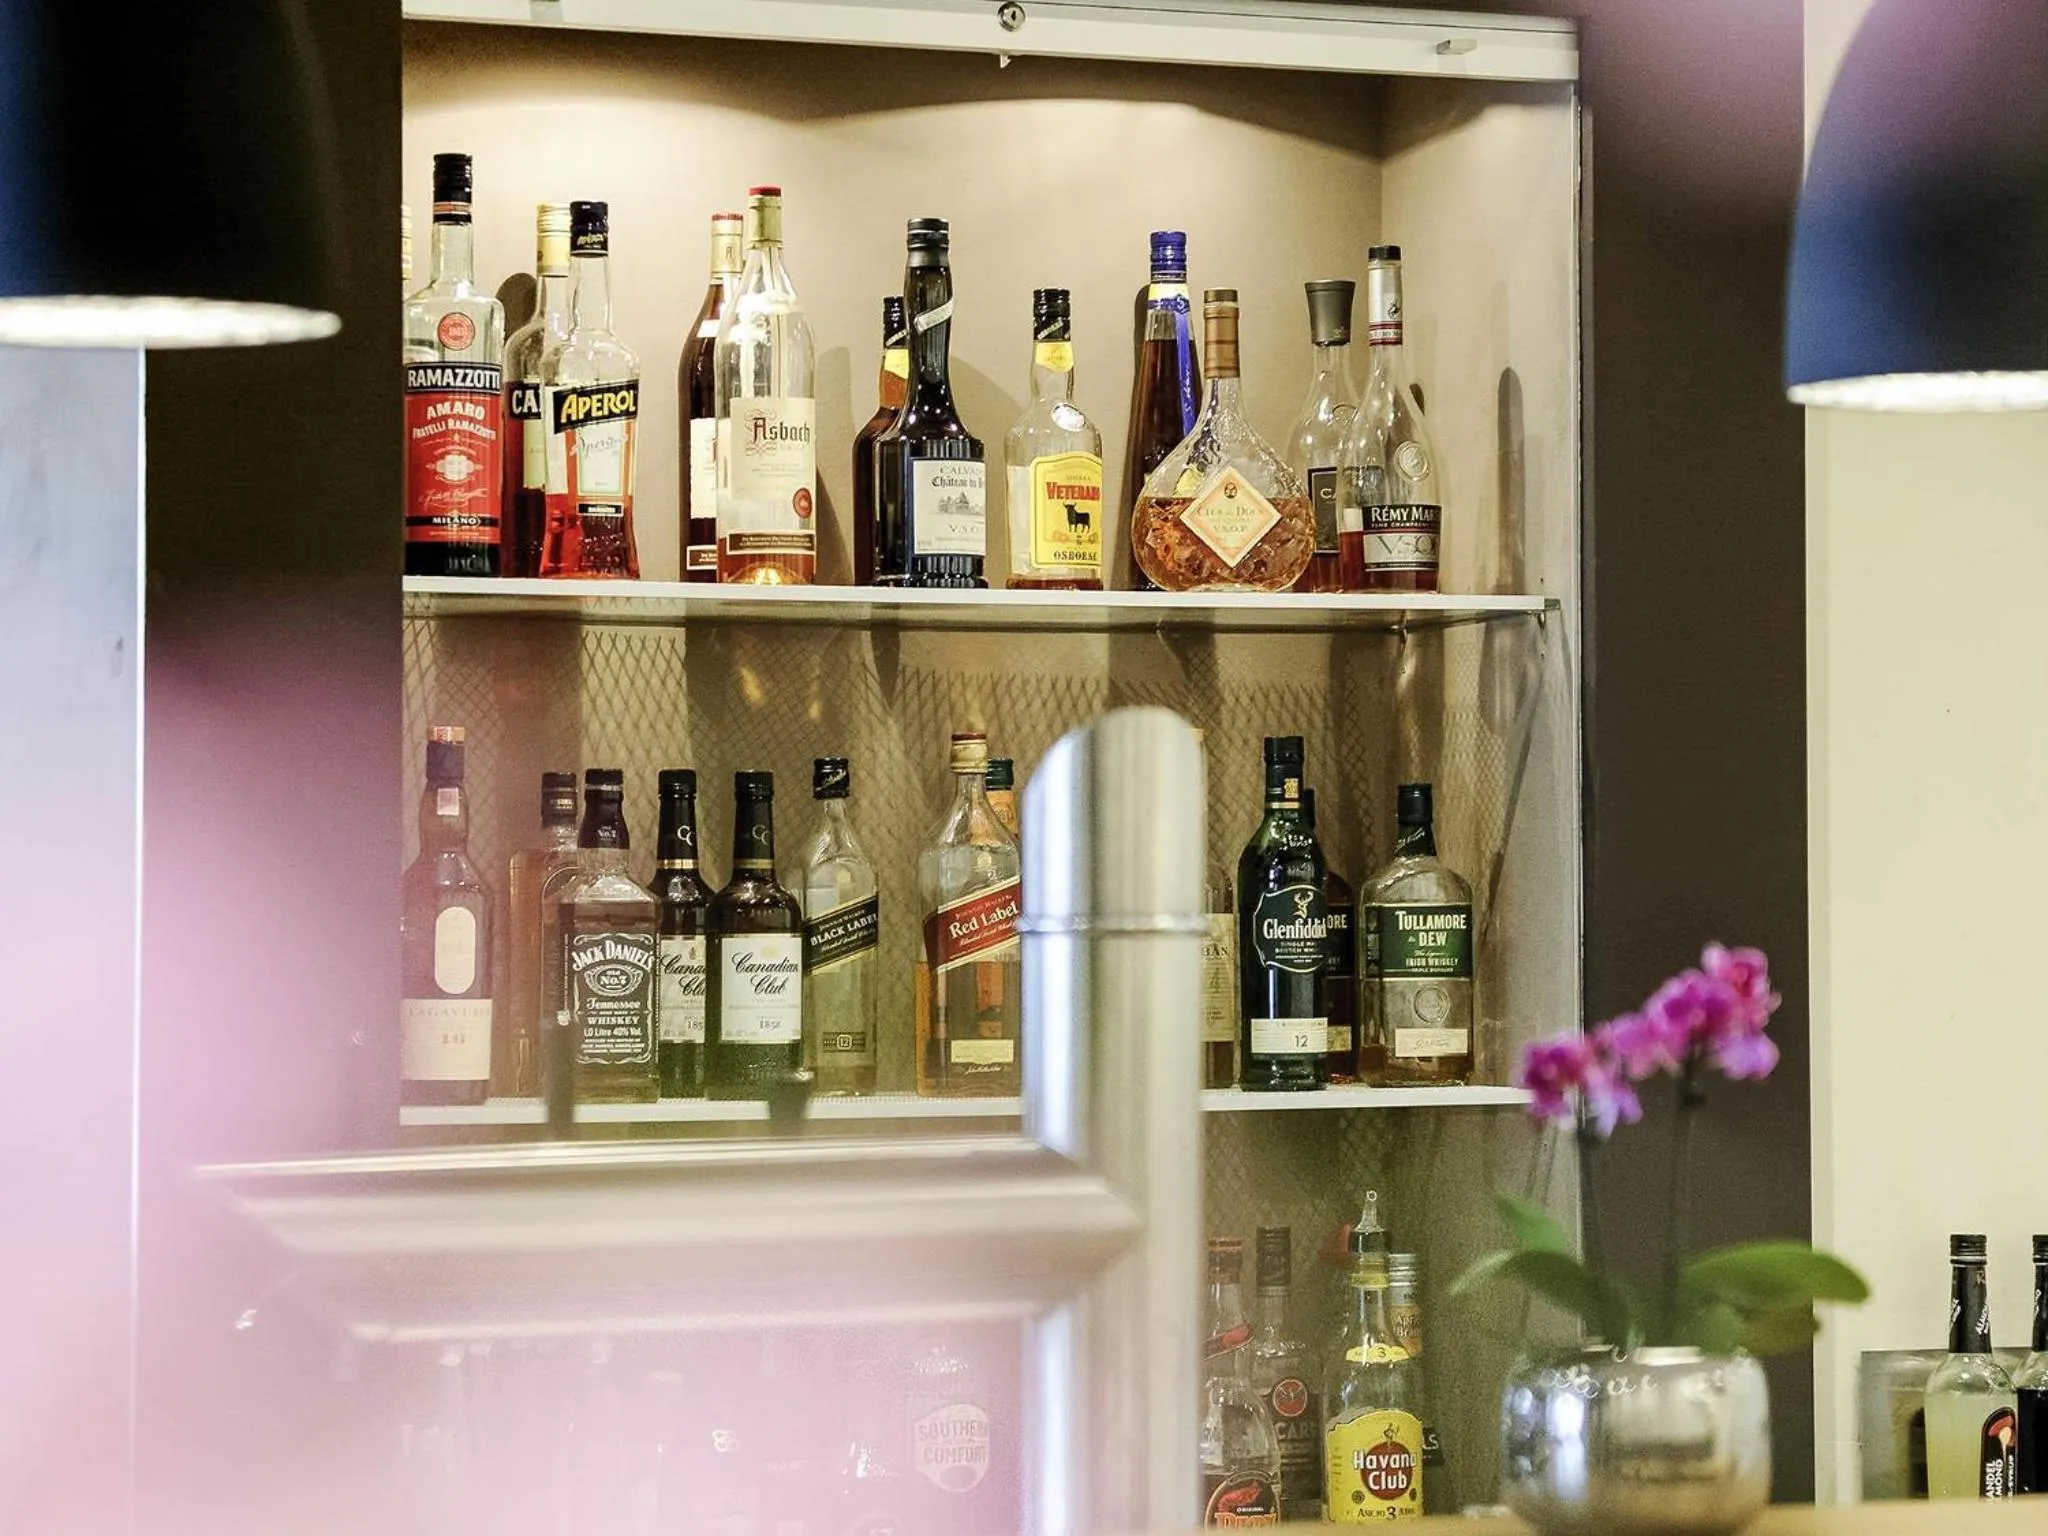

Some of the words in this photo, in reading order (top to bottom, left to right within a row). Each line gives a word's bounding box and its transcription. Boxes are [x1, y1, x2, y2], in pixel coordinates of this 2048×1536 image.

[427, 401, 485, 420] AMARO
[512, 389, 542, 414] CA
[560, 390, 636, 424] APEROL
[752, 417, 811, 444] Asbach
[432, 516, 476, 525] MILANO
[1371, 506, 1410, 522] RÉMY
[949, 921, 980, 940] Red
[980, 900, 1018, 927] Label
[1395, 911, 1467, 930] TULLAMORE
[810, 926, 845, 946] BLACK
[1419, 931, 1447, 947] DEW
[571, 945, 605, 972] JACK
[732, 951, 799, 973] Canadian
[750, 974, 789, 995] Club
[586, 997, 641, 1010] Tennessee
[587, 1016, 640, 1025] WHISKEY
[1294, 1035, 1309, 1048] 12
[1354, 1449, 1417, 1470] Havana
[1368, 1470, 1407, 1491] Club
[1387, 1505, 1397, 1520] 3
